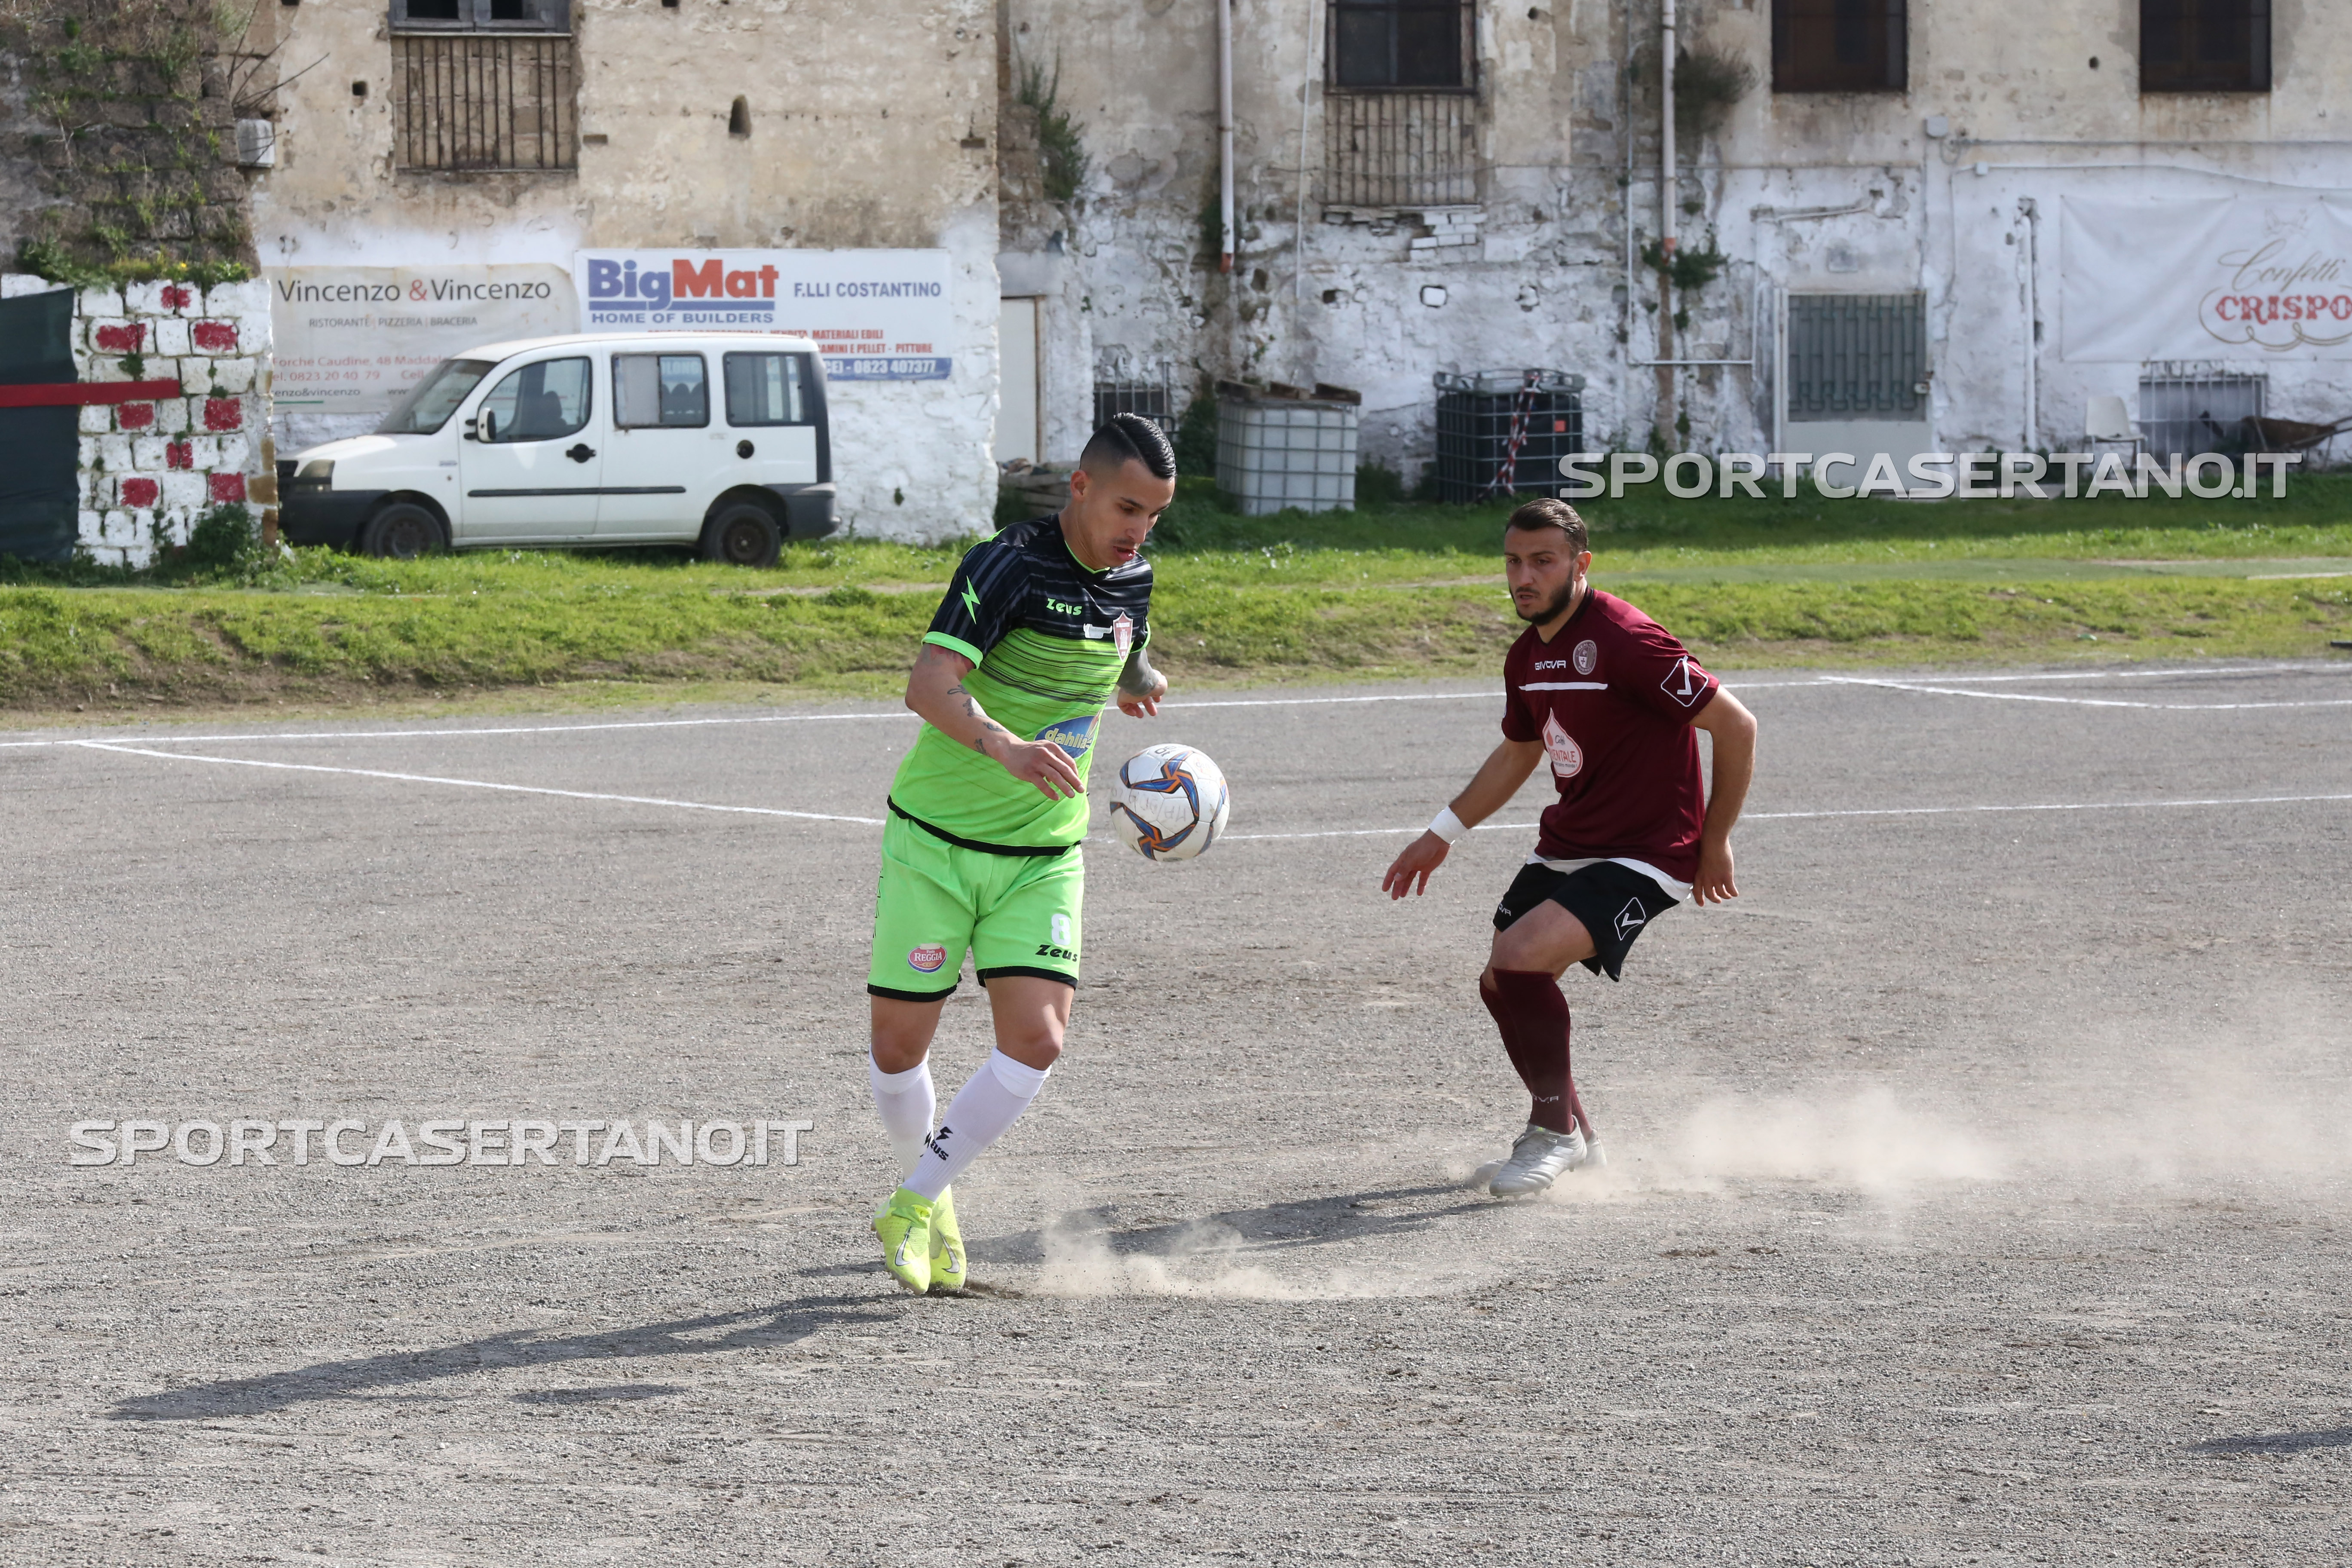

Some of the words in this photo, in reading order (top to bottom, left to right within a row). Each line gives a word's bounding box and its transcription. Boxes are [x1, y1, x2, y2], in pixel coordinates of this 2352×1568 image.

[2217, 239, 2346, 292] Confetti
[279, 280, 400, 301] Vincenzo
[409, 279, 427, 301] &
[430, 279, 551, 300] Vincenzo
[588, 259, 779, 310] BigMat
[794, 282, 830, 298] F.LLI
[836, 282, 941, 297] COSTANTINO
[2215, 295, 2352, 325] CRISPO
[309, 317, 370, 327] RISTORANTE
[378, 317, 422, 326] PIZZERIA
[431, 317, 477, 326] BRACERIA
[592, 313, 645, 324] HOME
[653, 313, 676, 323] OF
[683, 312, 773, 323] BUILDERS
[812, 330, 859, 339] MATERIALI
[818, 344, 847, 353] AMINI
[857, 344, 886, 353] PELLET
[318, 356, 373, 367] Caudine,
[377, 357, 391, 365] 48
[854, 360, 888, 374] 0823
[890, 360, 936, 373] 407377
[273, 372, 286, 381] el.
[290, 372, 321, 381] 0823
[325, 372, 340, 381] 20
[343, 371, 358, 380] 40
[365, 371, 380, 380] 79
[272, 388, 360, 396] enzo&vincenzo
[1046, 598, 1082, 616] Zeus
[1535, 660, 1566, 670] GIVOVA
[1045, 728, 1087, 749] dahlia
[1051, 913, 1072, 945] 8
[914, 952, 942, 962] REGGIA
[1035, 944, 1078, 962] Zeus
